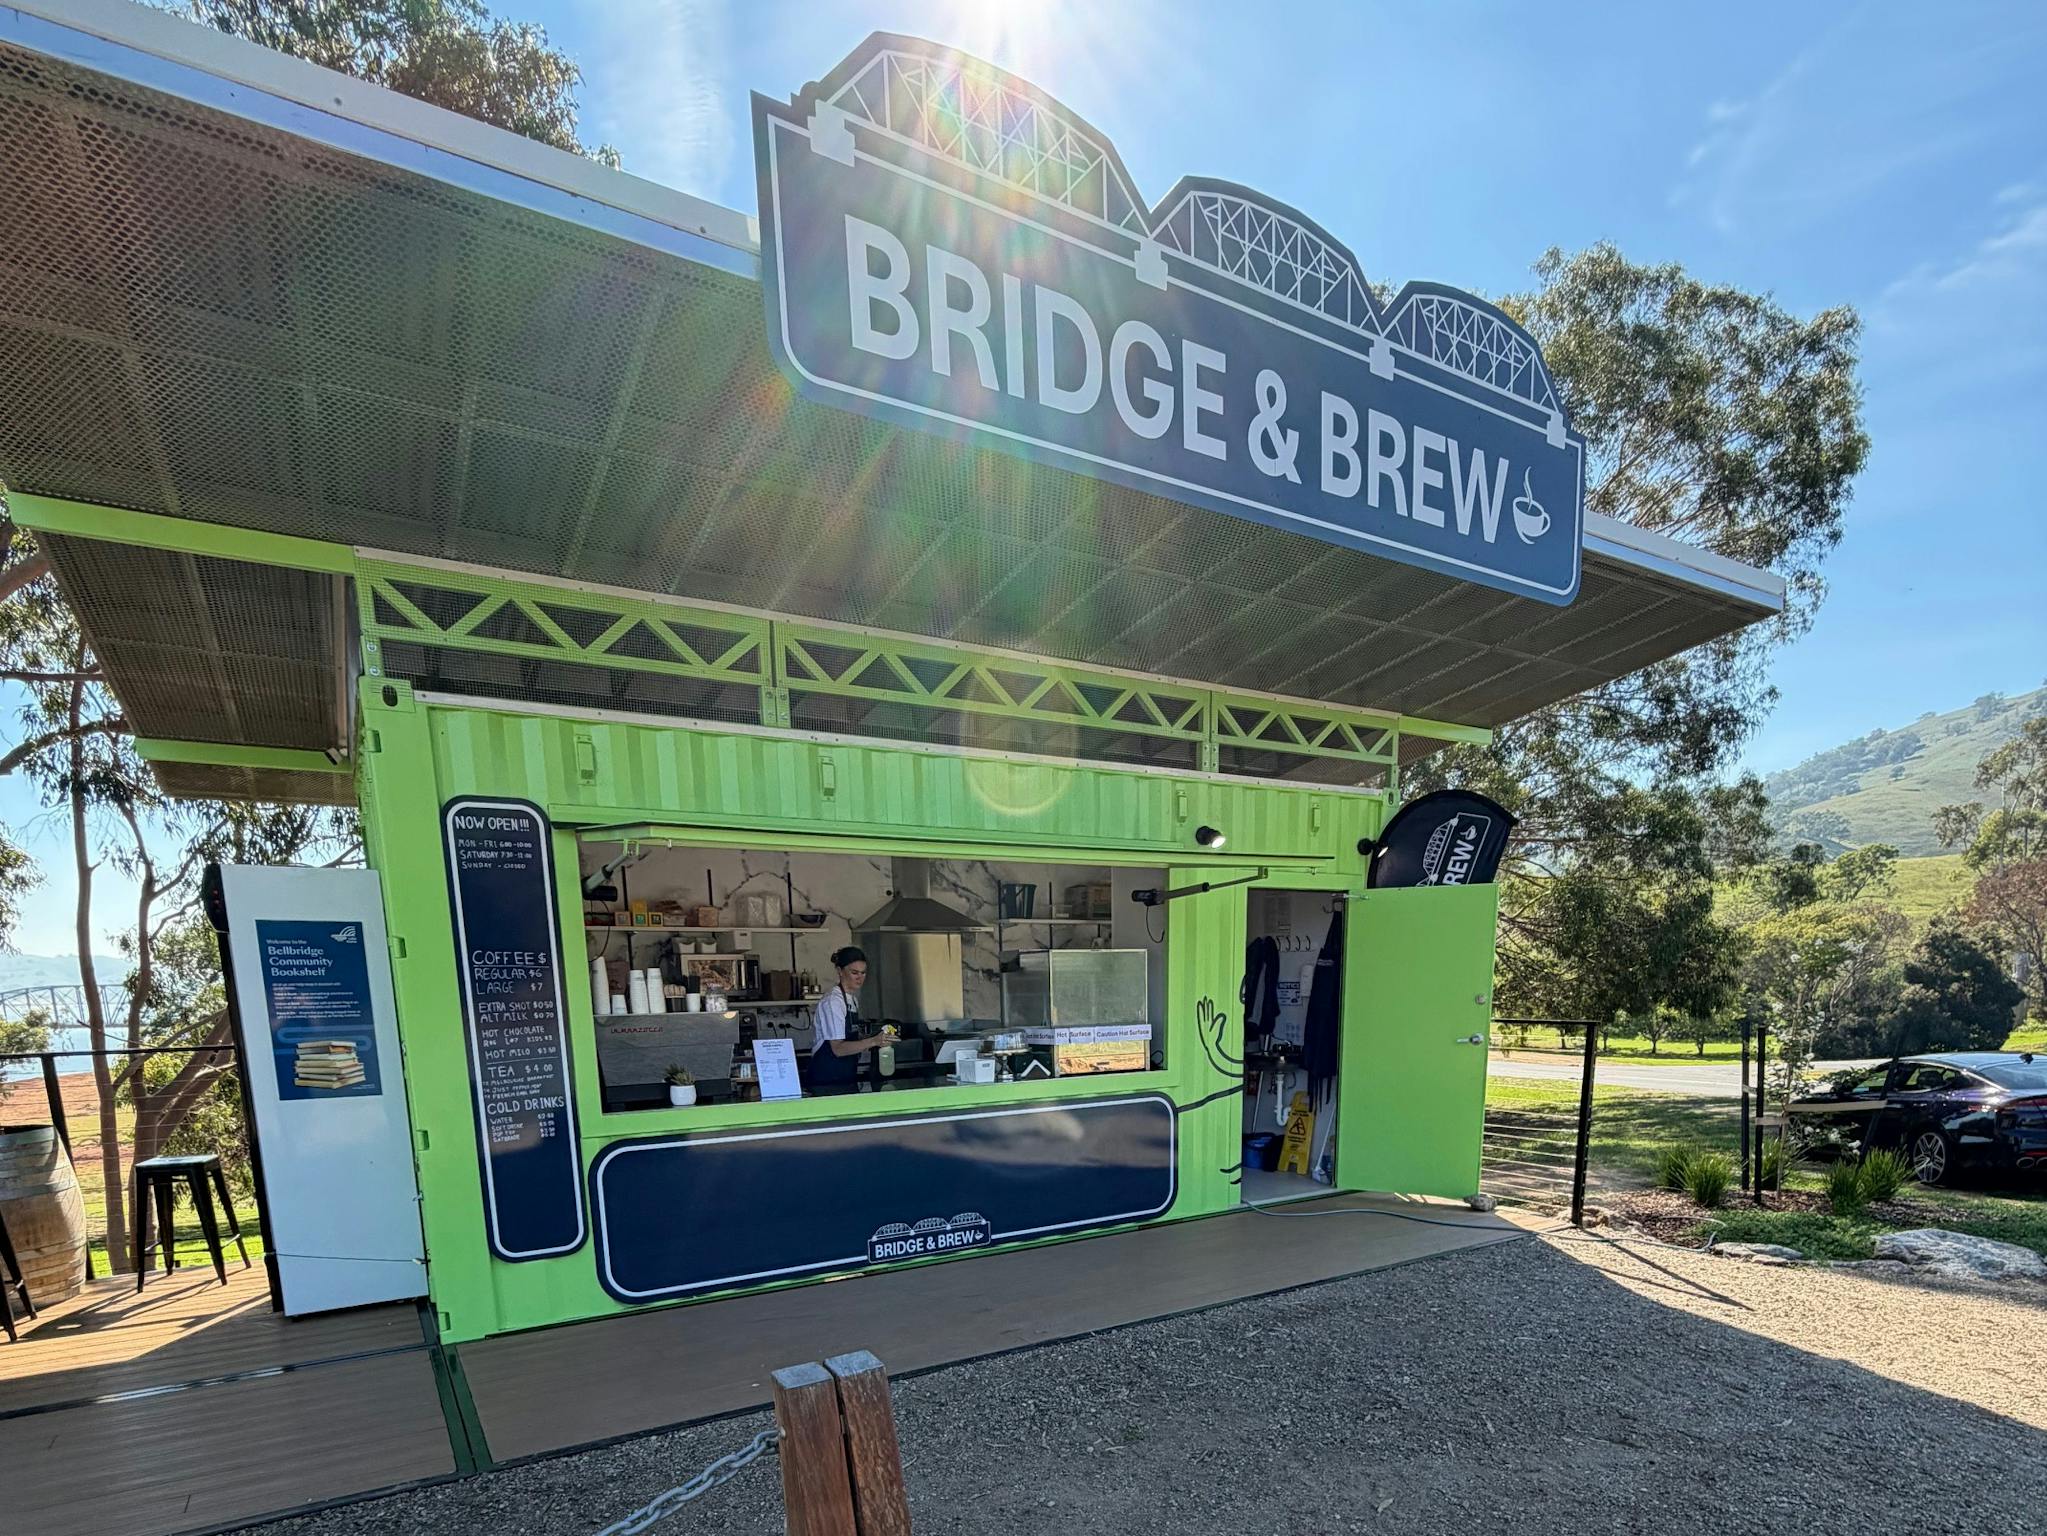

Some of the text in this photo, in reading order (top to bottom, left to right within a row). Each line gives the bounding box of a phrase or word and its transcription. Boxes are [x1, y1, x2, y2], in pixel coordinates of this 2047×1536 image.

[844, 214, 1509, 544] BRIDGE & BREW
[454, 816, 484, 829] NOW
[458, 839, 476, 848] MON
[484, 840, 497, 848] FRI
[460, 850, 498, 860] SATURDAY
[1442, 840, 1474, 884] REW
[268, 946, 324, 957] Bellbridge
[472, 950, 534, 965] COFFEE
[269, 957, 333, 967] Community
[271, 967, 326, 976] Bookshelf
[474, 968, 527, 980] REGULAR
[476, 981, 515, 995] LARGE
[478, 1002, 506, 1013] EXTRA
[509, 1002, 530, 1011] SHOT
[480, 1013, 500, 1023] ALT
[504, 1012, 528, 1021] MILK
[481, 1026, 544, 1038] HOT CHOCOLATE
[485, 1050, 505, 1060] HOT
[509, 1048, 530, 1057] MILO
[488, 1066, 515, 1078] TEA
[487, 1096, 565, 1114] COLD DRINKS
[875, 1230, 974, 1258] BRIDGE & BREW
